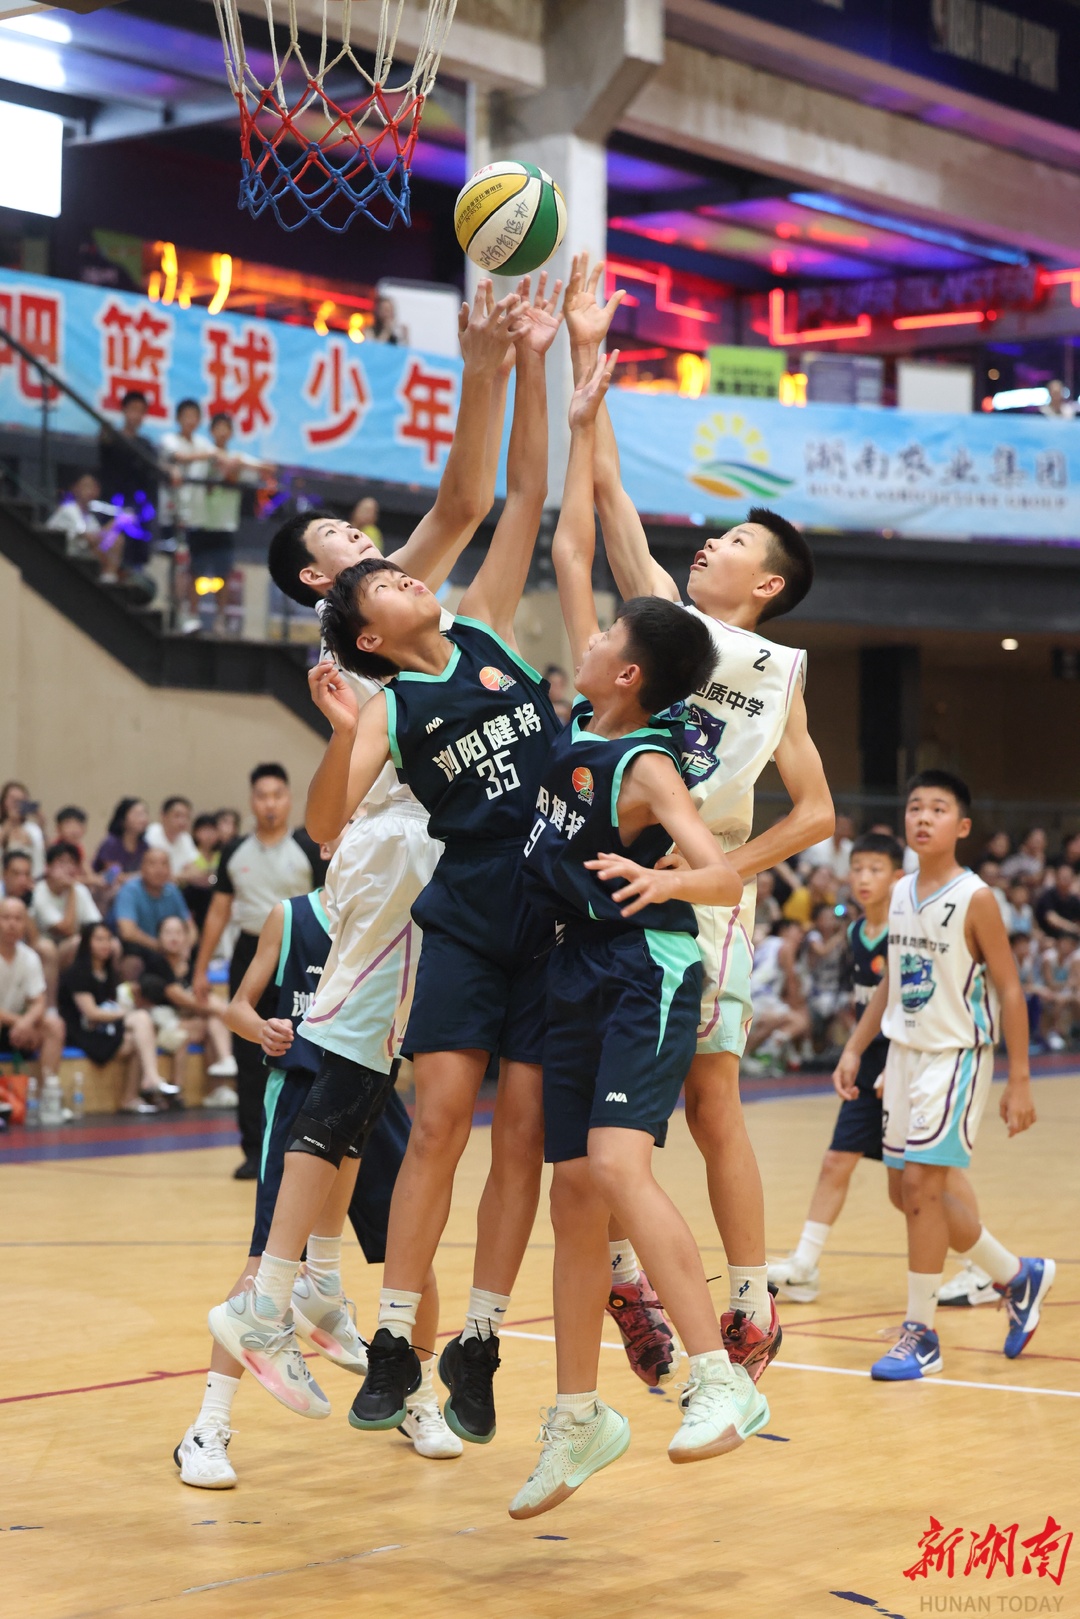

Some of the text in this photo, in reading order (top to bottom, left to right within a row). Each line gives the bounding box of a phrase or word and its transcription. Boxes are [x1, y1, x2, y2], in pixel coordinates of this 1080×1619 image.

[806, 439, 1067, 489] 湖南农业集团
[752, 649, 771, 672] 2
[432, 703, 542, 782] 浏阳健将
[476, 750, 521, 800] 35
[523, 818, 547, 858] 9
[941, 902, 956, 927] 7
